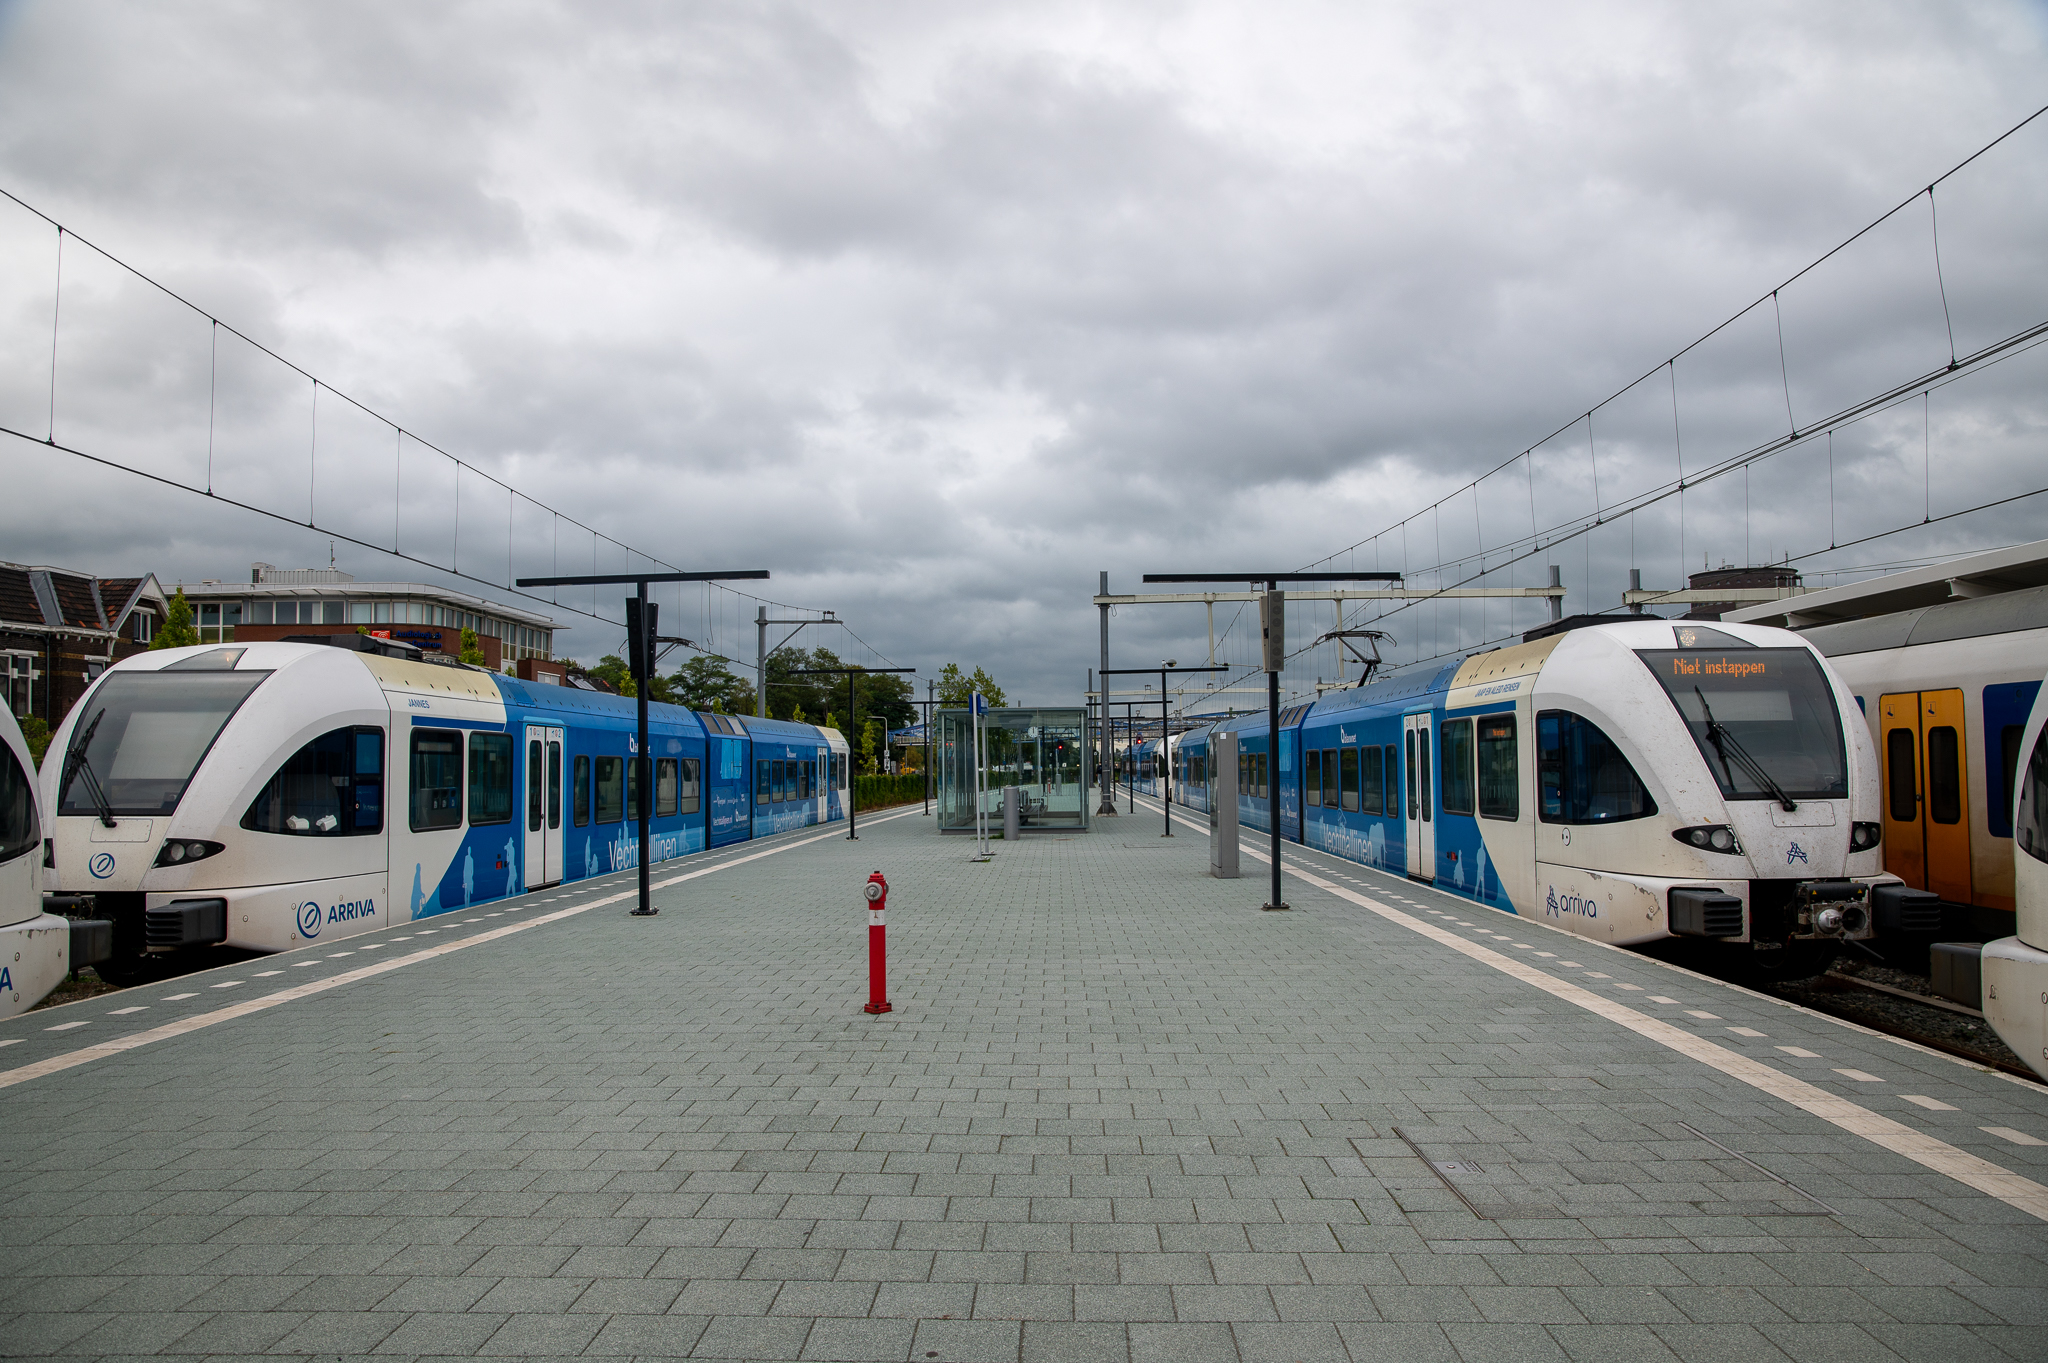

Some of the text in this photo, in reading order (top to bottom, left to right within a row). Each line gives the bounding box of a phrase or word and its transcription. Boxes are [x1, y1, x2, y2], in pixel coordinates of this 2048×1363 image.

[412, 640, 442, 648] Centrum
[1674, 658, 1765, 677] Niet instappen
[408, 699, 430, 709] JANNES
[608, 833, 677, 872] Vechtllijnen
[327, 898, 376, 925] ARRIVA
[1560, 892, 1597, 919] arriva
